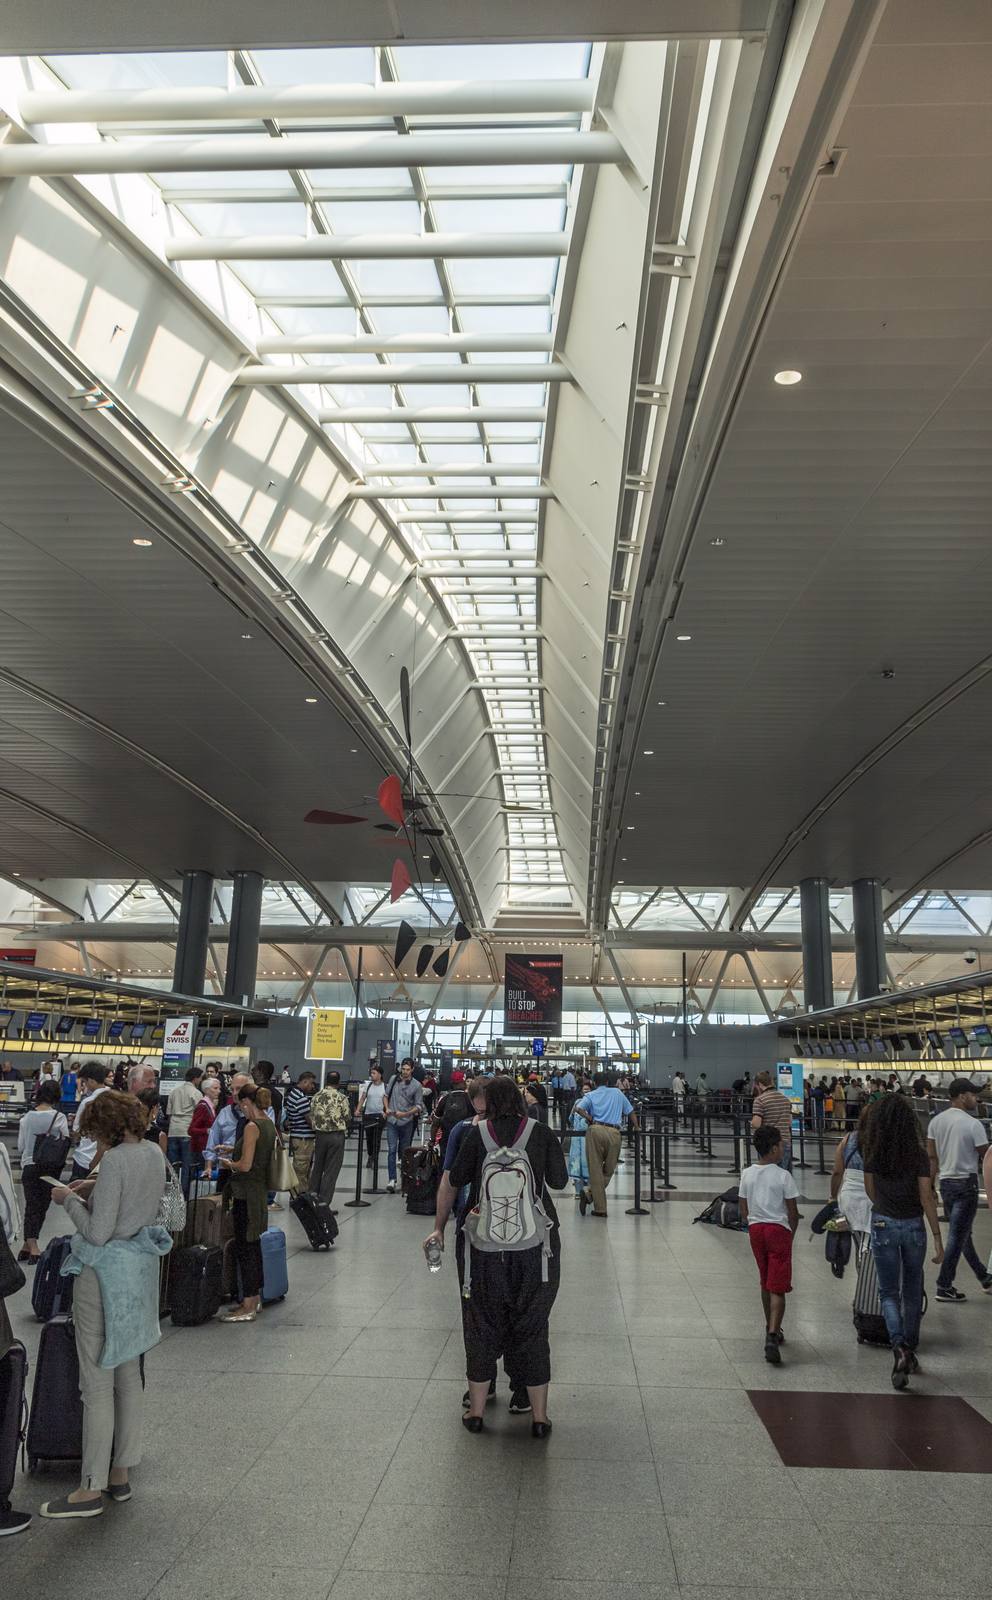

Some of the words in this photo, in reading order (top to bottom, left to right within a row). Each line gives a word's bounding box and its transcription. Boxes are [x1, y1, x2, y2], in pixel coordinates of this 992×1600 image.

[508, 990, 526, 1000] BUILT
[508, 1000, 516, 1010] TO
[519, 1001, 536, 1010] STOP
